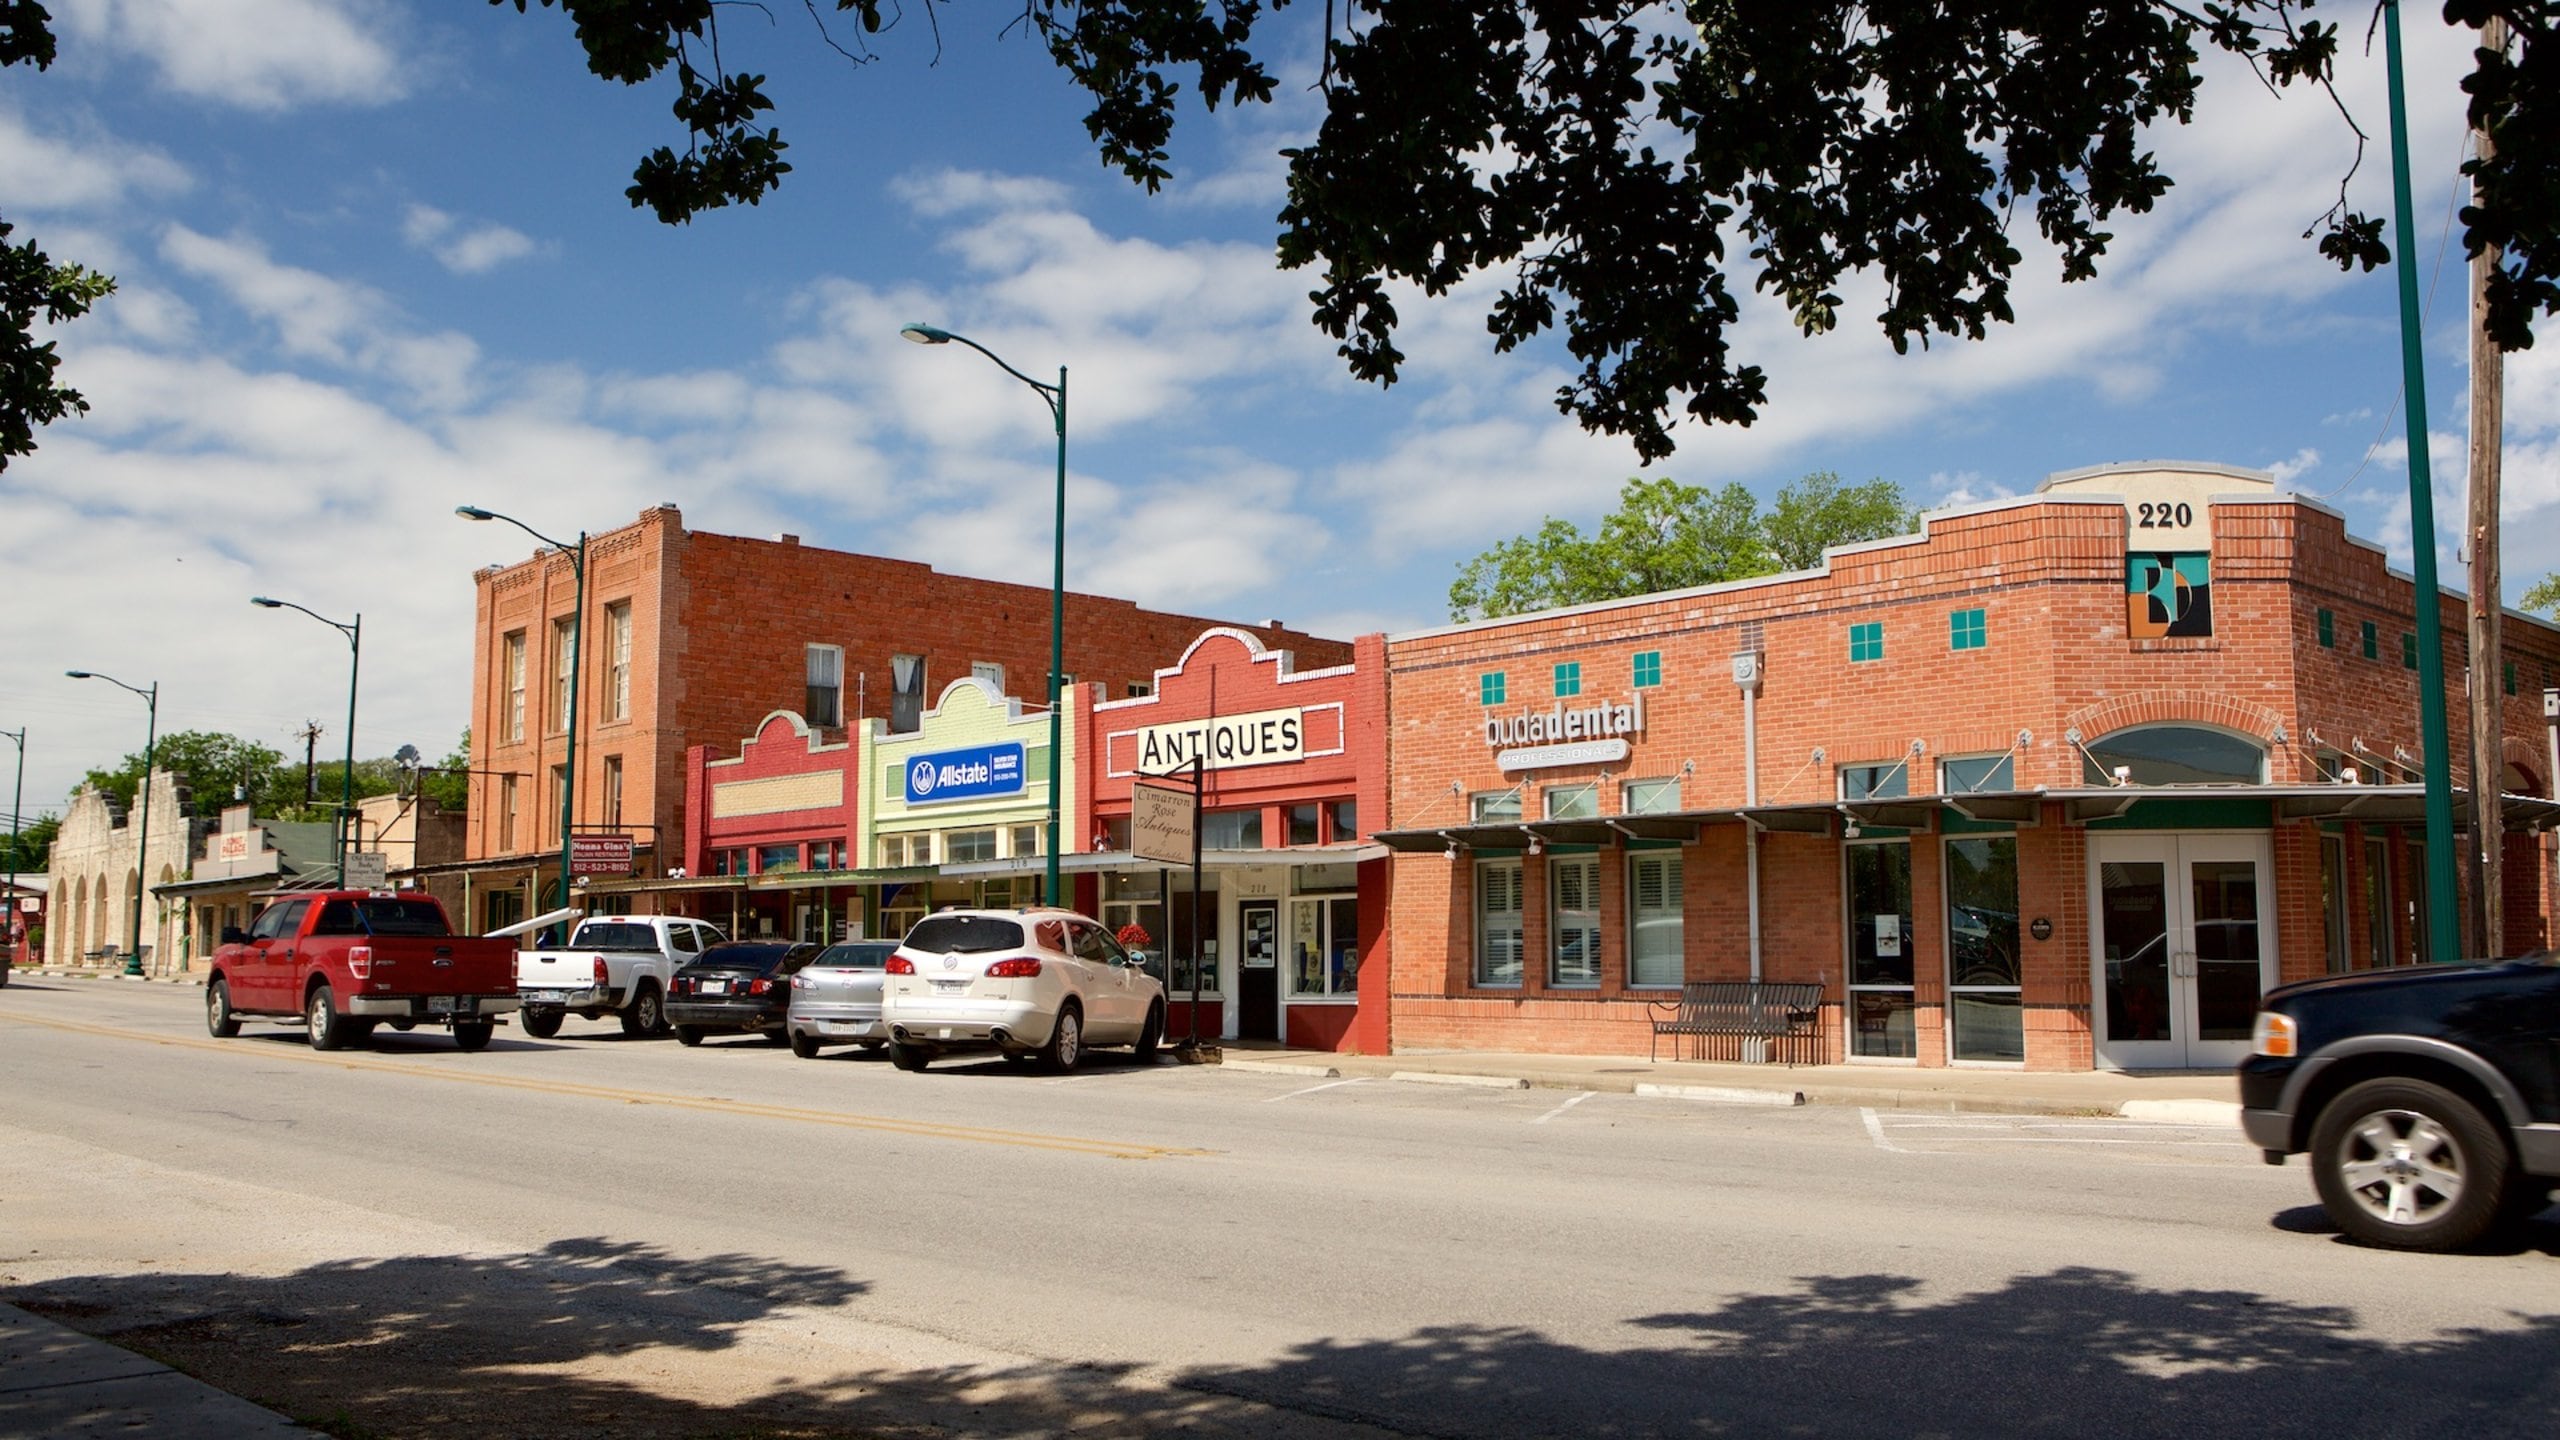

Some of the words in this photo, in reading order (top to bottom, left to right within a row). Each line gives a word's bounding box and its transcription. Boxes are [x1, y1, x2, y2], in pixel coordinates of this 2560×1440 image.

[2138, 503, 2193, 530] 220
[1485, 691, 1643, 747] budadental
[1142, 718, 1299, 767] ANTIQUES
[1503, 743, 1621, 763] PROFESSIONALS
[936, 761, 989, 788] Allstate
[1138, 788, 1191, 807] Cimarron
[1151, 802, 1177, 818] Rose
[1135, 814, 1191, 838] Antiques
[573, 842, 601, 850] Nonna
